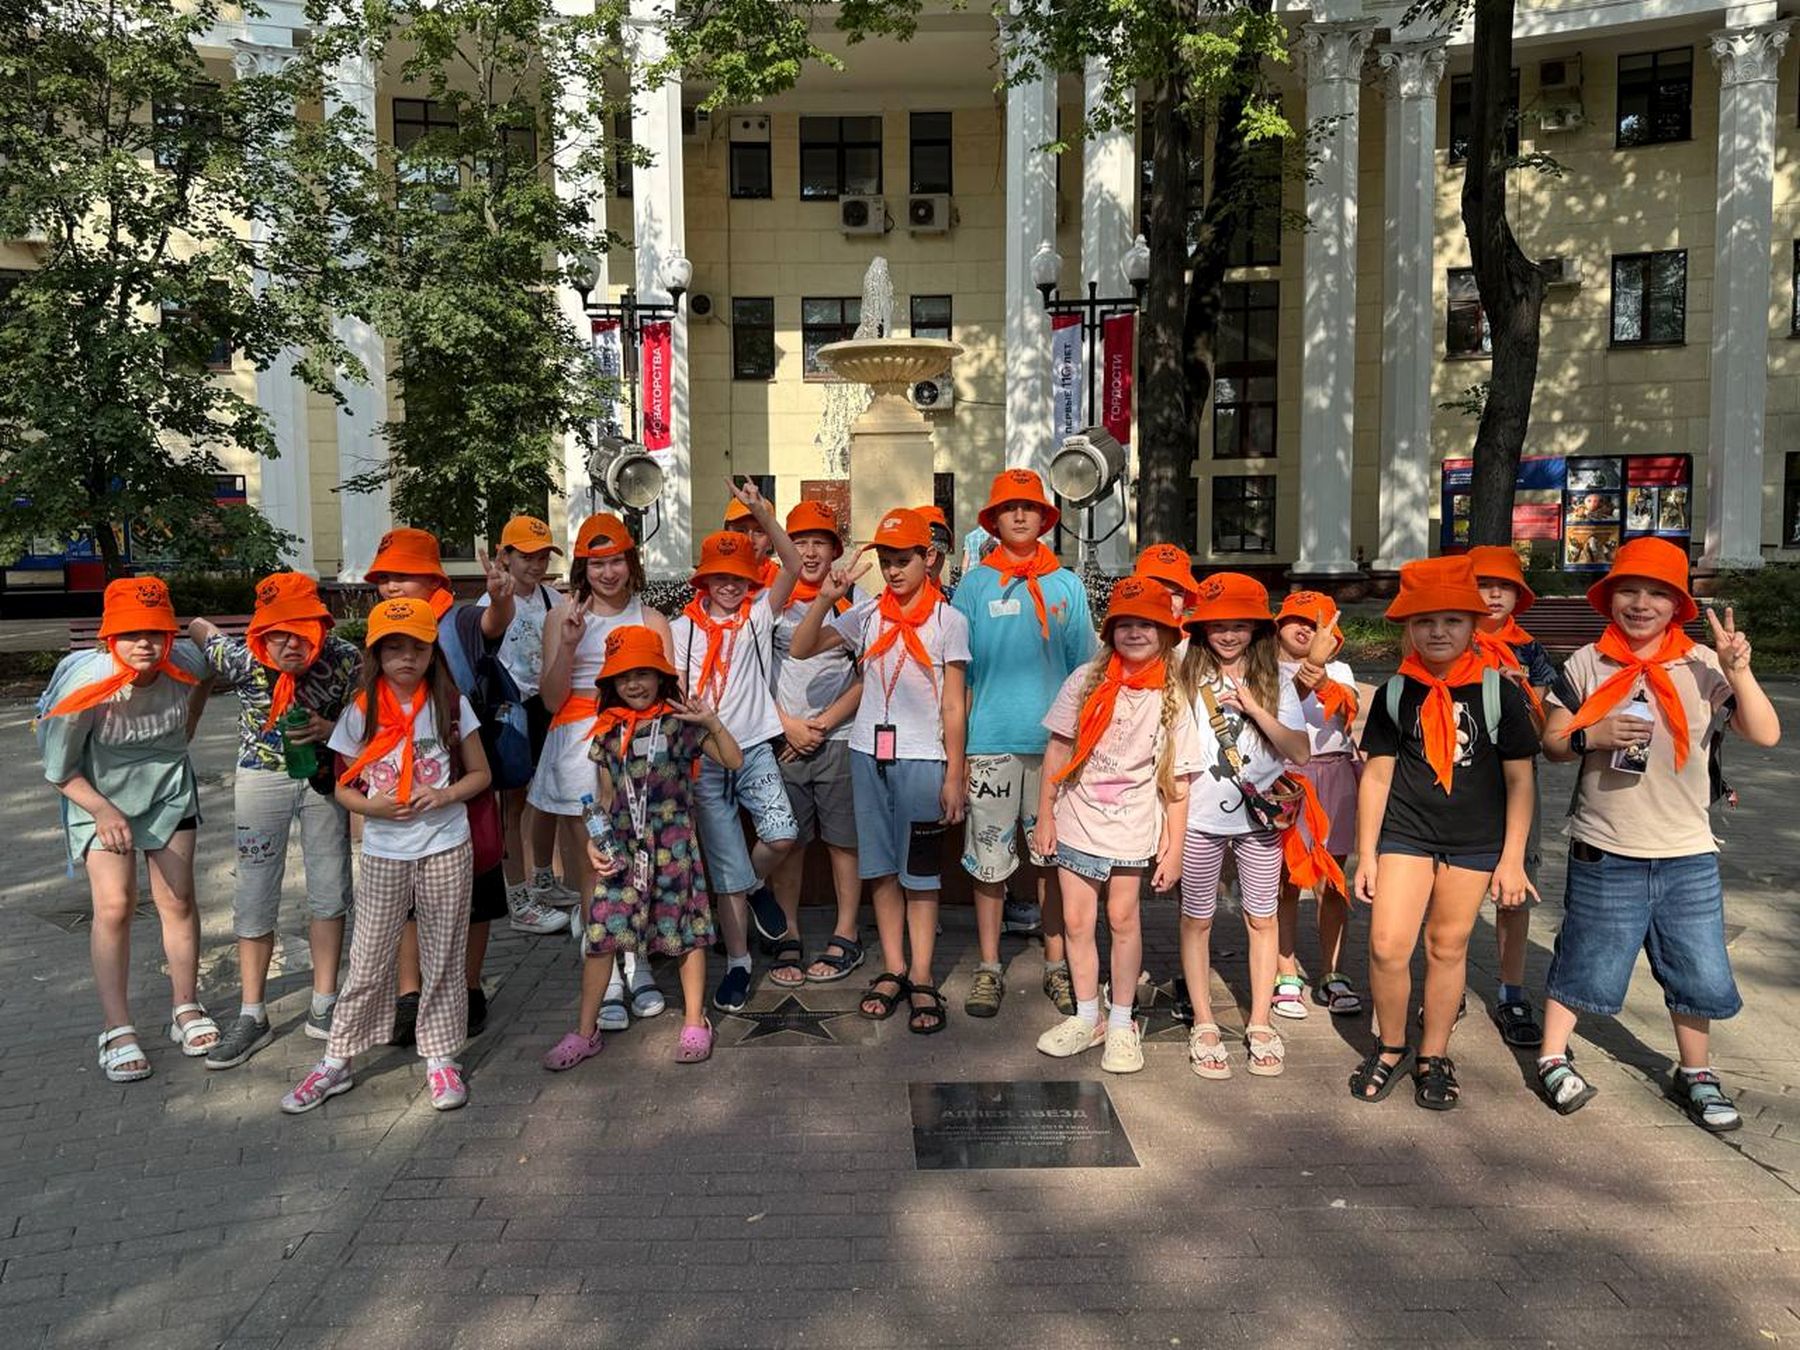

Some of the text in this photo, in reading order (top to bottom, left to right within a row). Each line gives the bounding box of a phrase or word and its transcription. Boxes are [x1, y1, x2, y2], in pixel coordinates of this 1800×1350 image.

[1064, 344, 1072, 364] ЛЕТ
[652, 346, 662, 440] НОВАТОРСТВА
[1110, 354, 1122, 422] ГОРДОСТИ
[1064, 390, 1073, 434] ПЕРВЫЕ
[941, 1109, 1088, 1119] АЛЛЕЯ ЗВЕЗД
